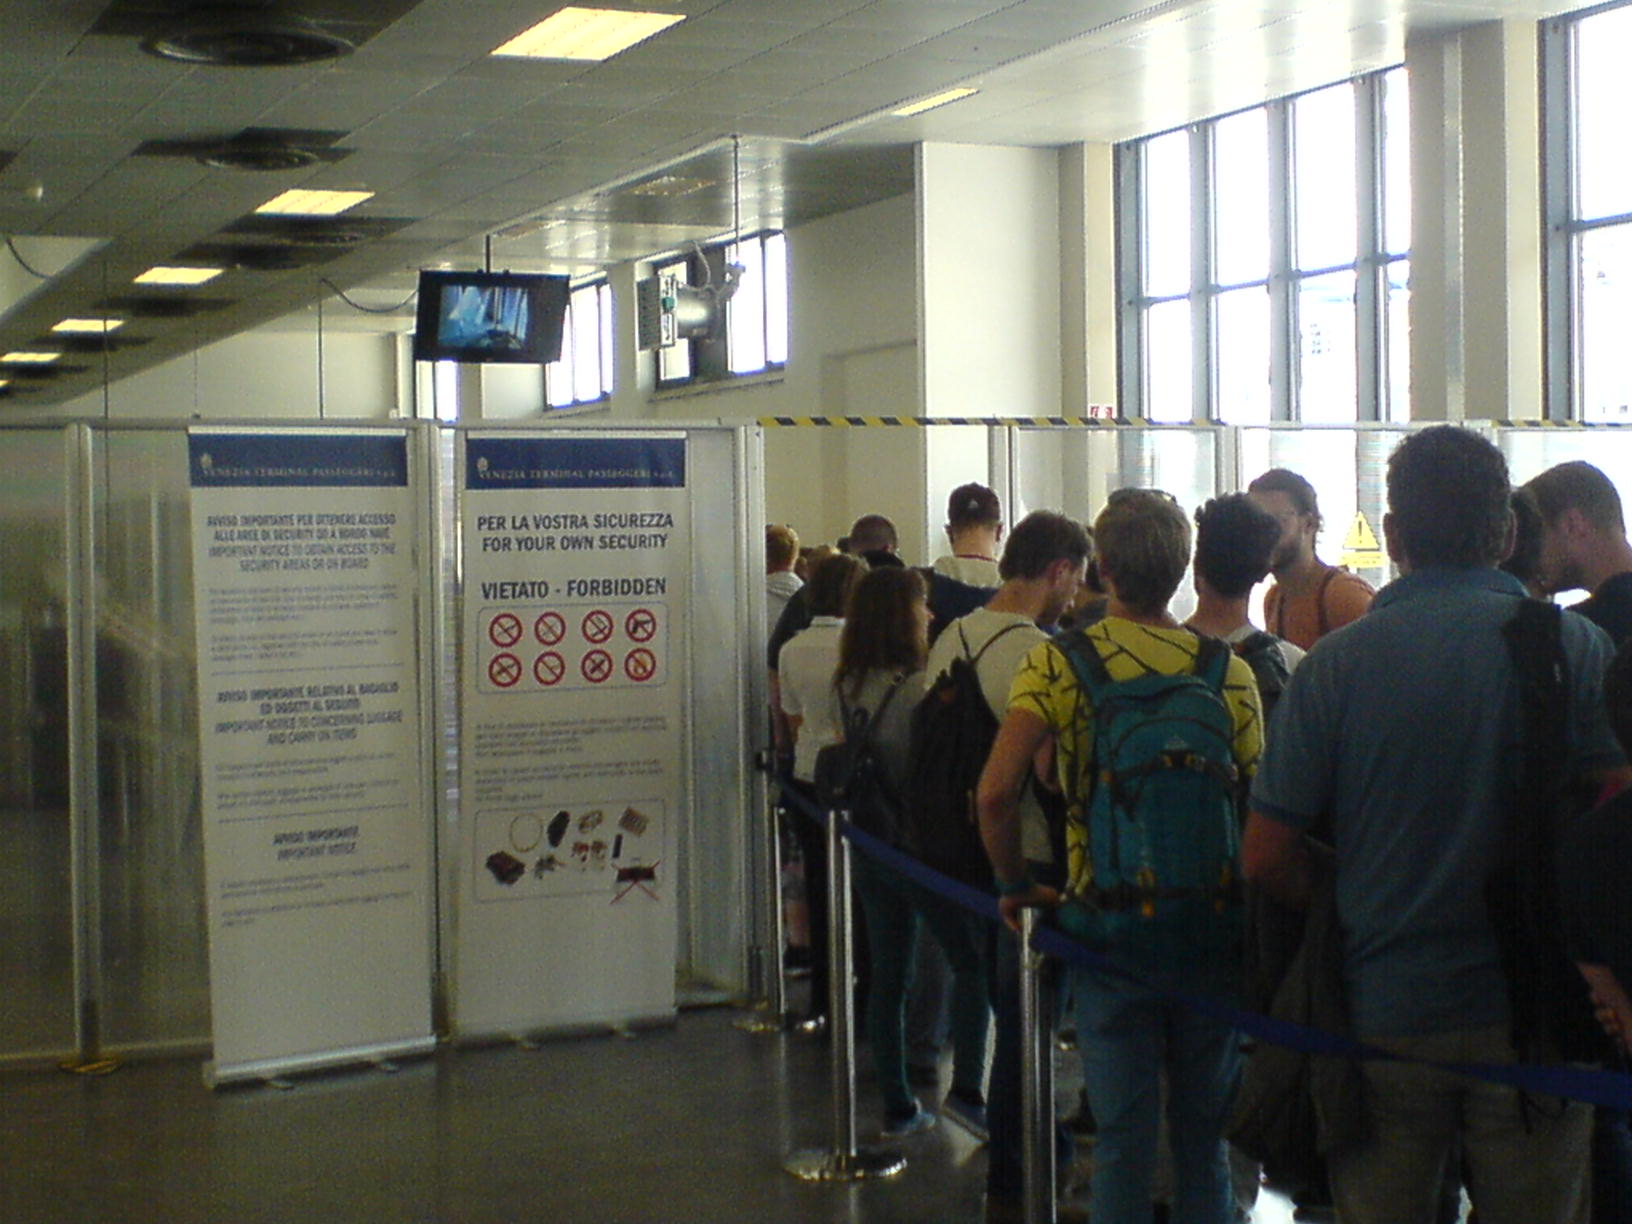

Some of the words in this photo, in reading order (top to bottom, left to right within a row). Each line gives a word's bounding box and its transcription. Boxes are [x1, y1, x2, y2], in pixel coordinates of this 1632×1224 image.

[477, 515, 506, 531] PER
[511, 515, 529, 530] LA
[533, 514, 589, 530] VOSTRA
[593, 512, 674, 529] SICUREZZA
[482, 536, 512, 552] FOR
[516, 536, 555, 551] YOUR
[560, 535, 594, 550] OWN
[598, 533, 668, 549] SECURITY
[481, 582, 549, 599] VIETATO
[567, 578, 666, 597] FORBIDDEN
